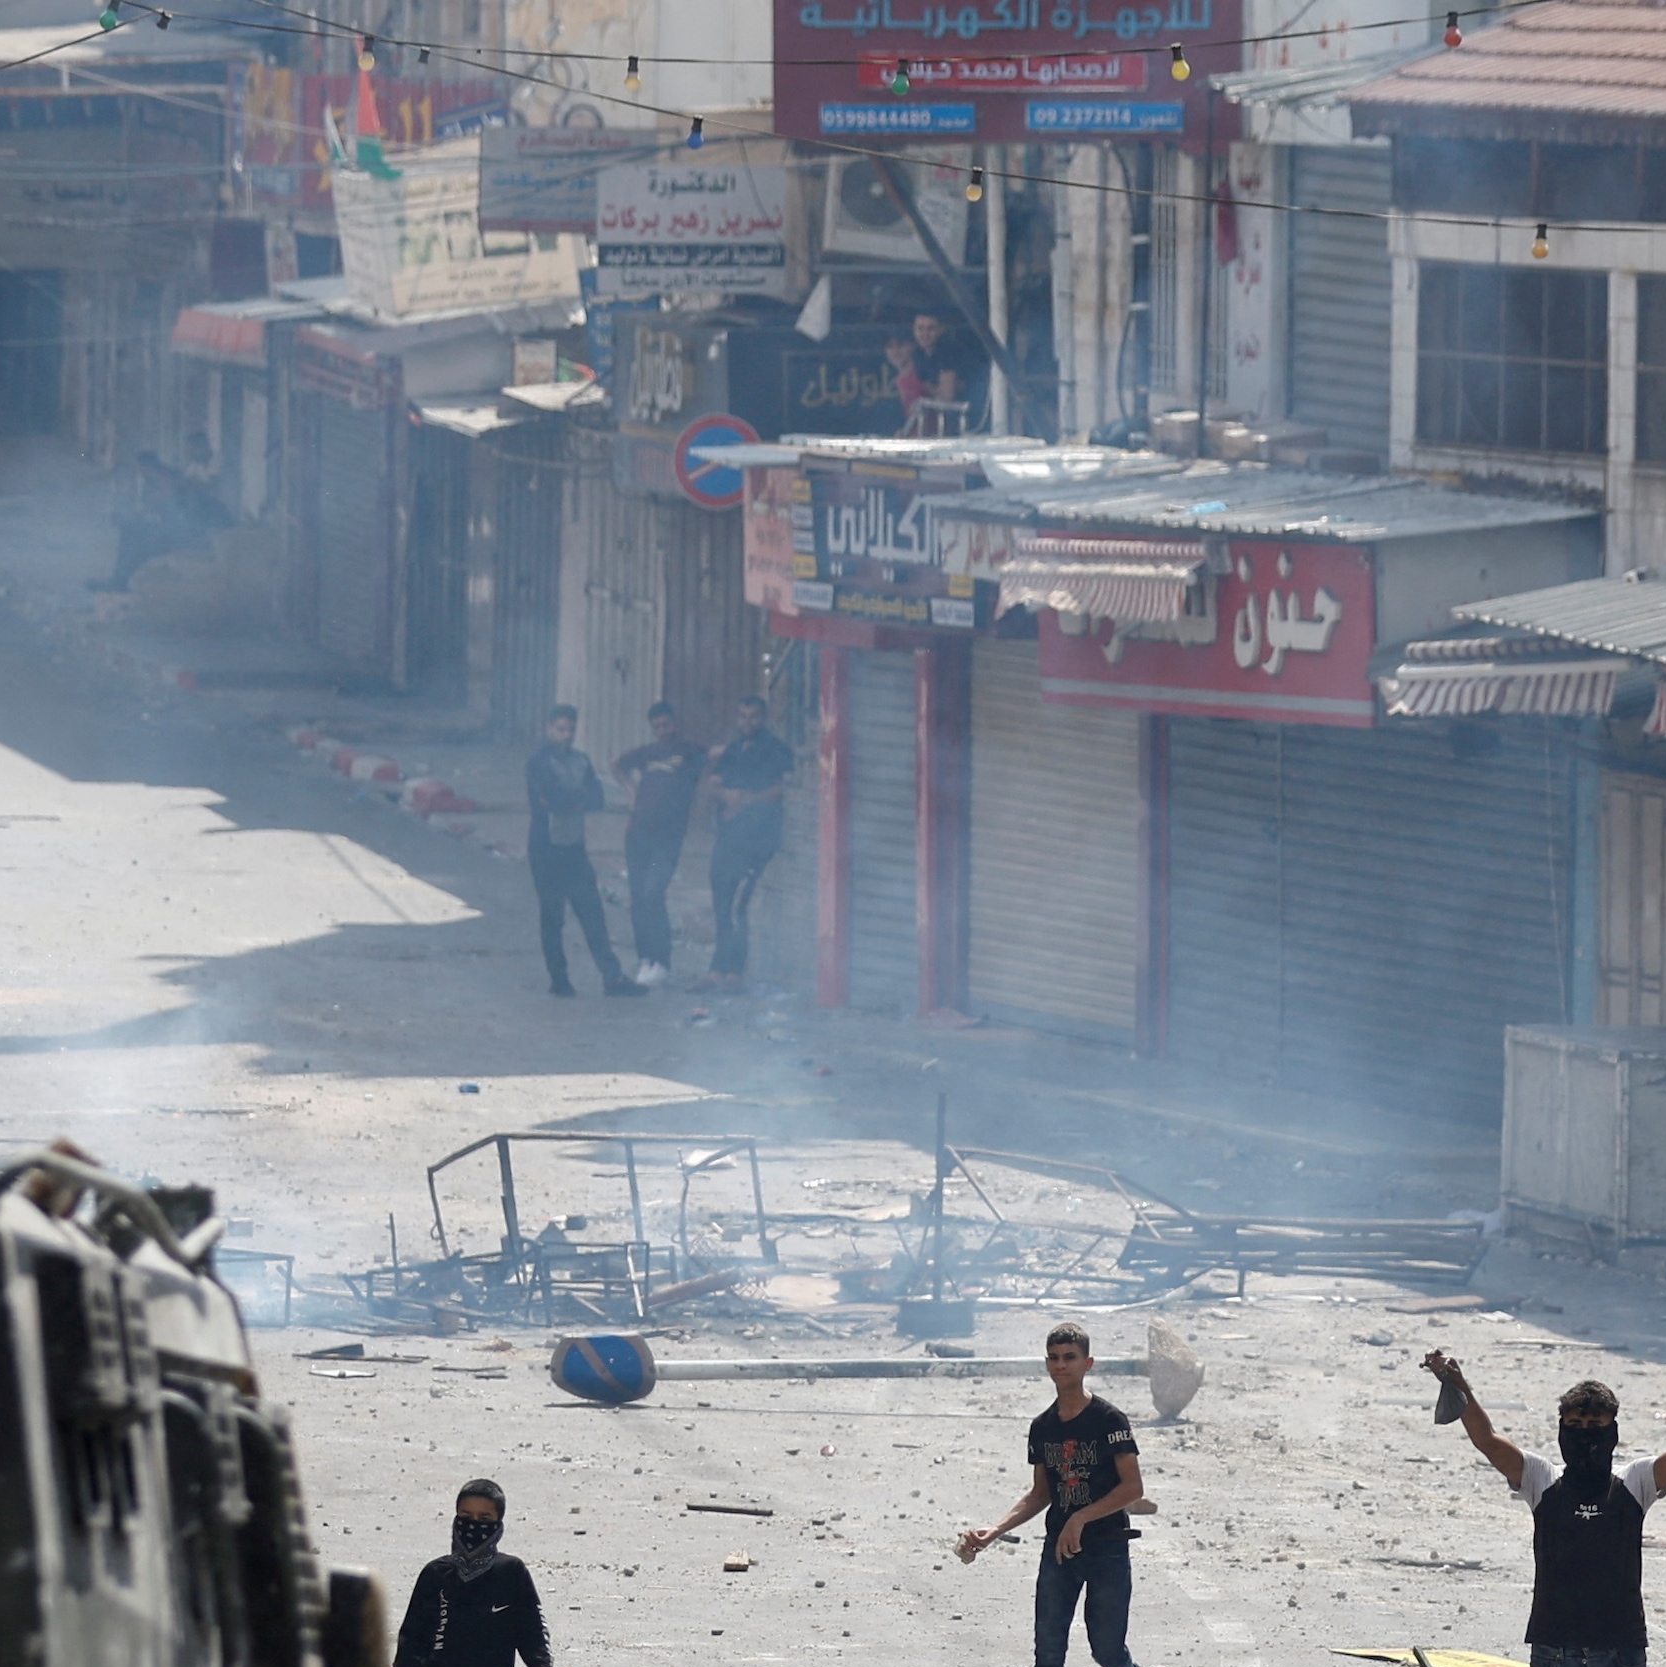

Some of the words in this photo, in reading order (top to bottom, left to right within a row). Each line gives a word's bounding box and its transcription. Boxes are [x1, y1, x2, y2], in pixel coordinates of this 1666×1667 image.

[648, 169, 737, 199] الدكتورة
[602, 204, 660, 237] بركات
[717, 203, 784, 236] نسرين
[827, 487, 941, 583] الكيلاني
[1234, 550, 1342, 676] حنون
